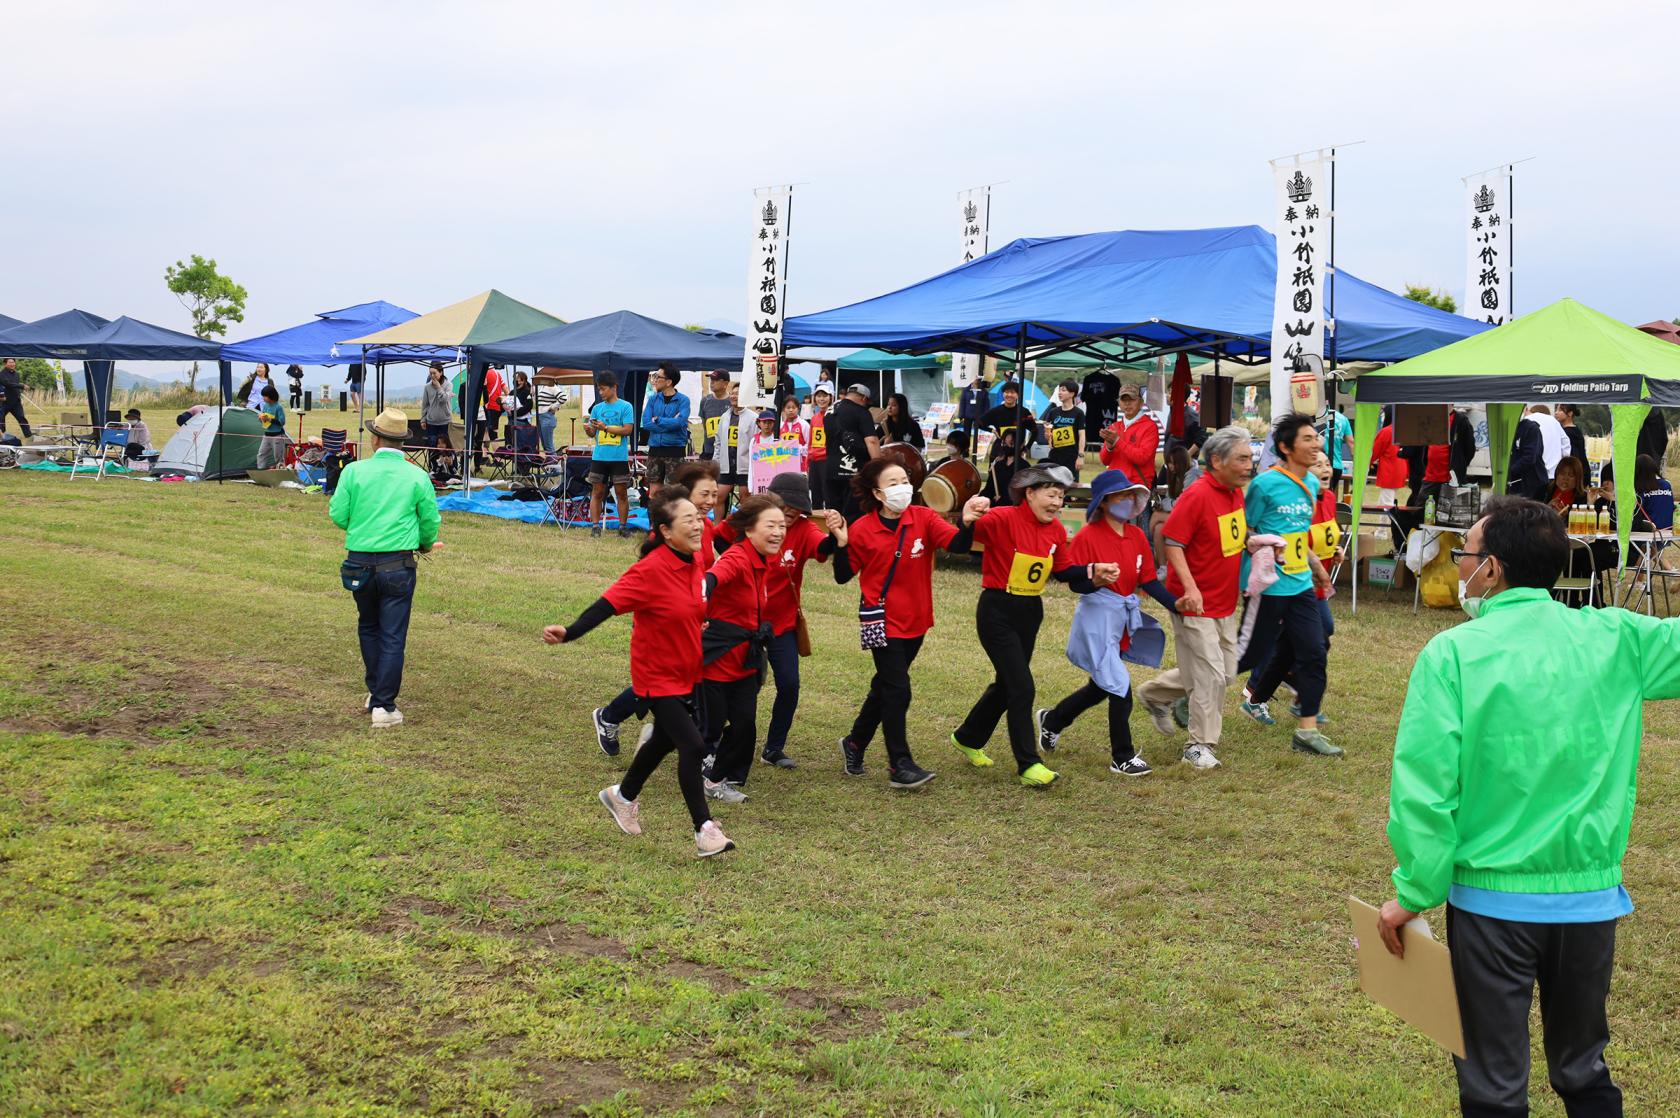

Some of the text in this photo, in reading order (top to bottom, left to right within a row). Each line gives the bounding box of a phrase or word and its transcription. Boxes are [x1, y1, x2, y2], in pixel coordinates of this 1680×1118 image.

[1284, 204, 1319, 223] 奉納
[1471, 213, 1500, 231] 奉納
[964, 225, 980, 236] 納
[1476, 232, 1504, 326] 小竹祇園
[1560, 383, 1589, 393] Folding
[1589, 382, 1610, 392] Patio
[1611, 382, 1629, 392] Tarp
[1056, 429, 1070, 441] 23
[1231, 517, 1239, 540] 6
[1325, 526, 1334, 546] 6
[1295, 537, 1302, 560] 6
[1028, 562, 1044, 583] 6
